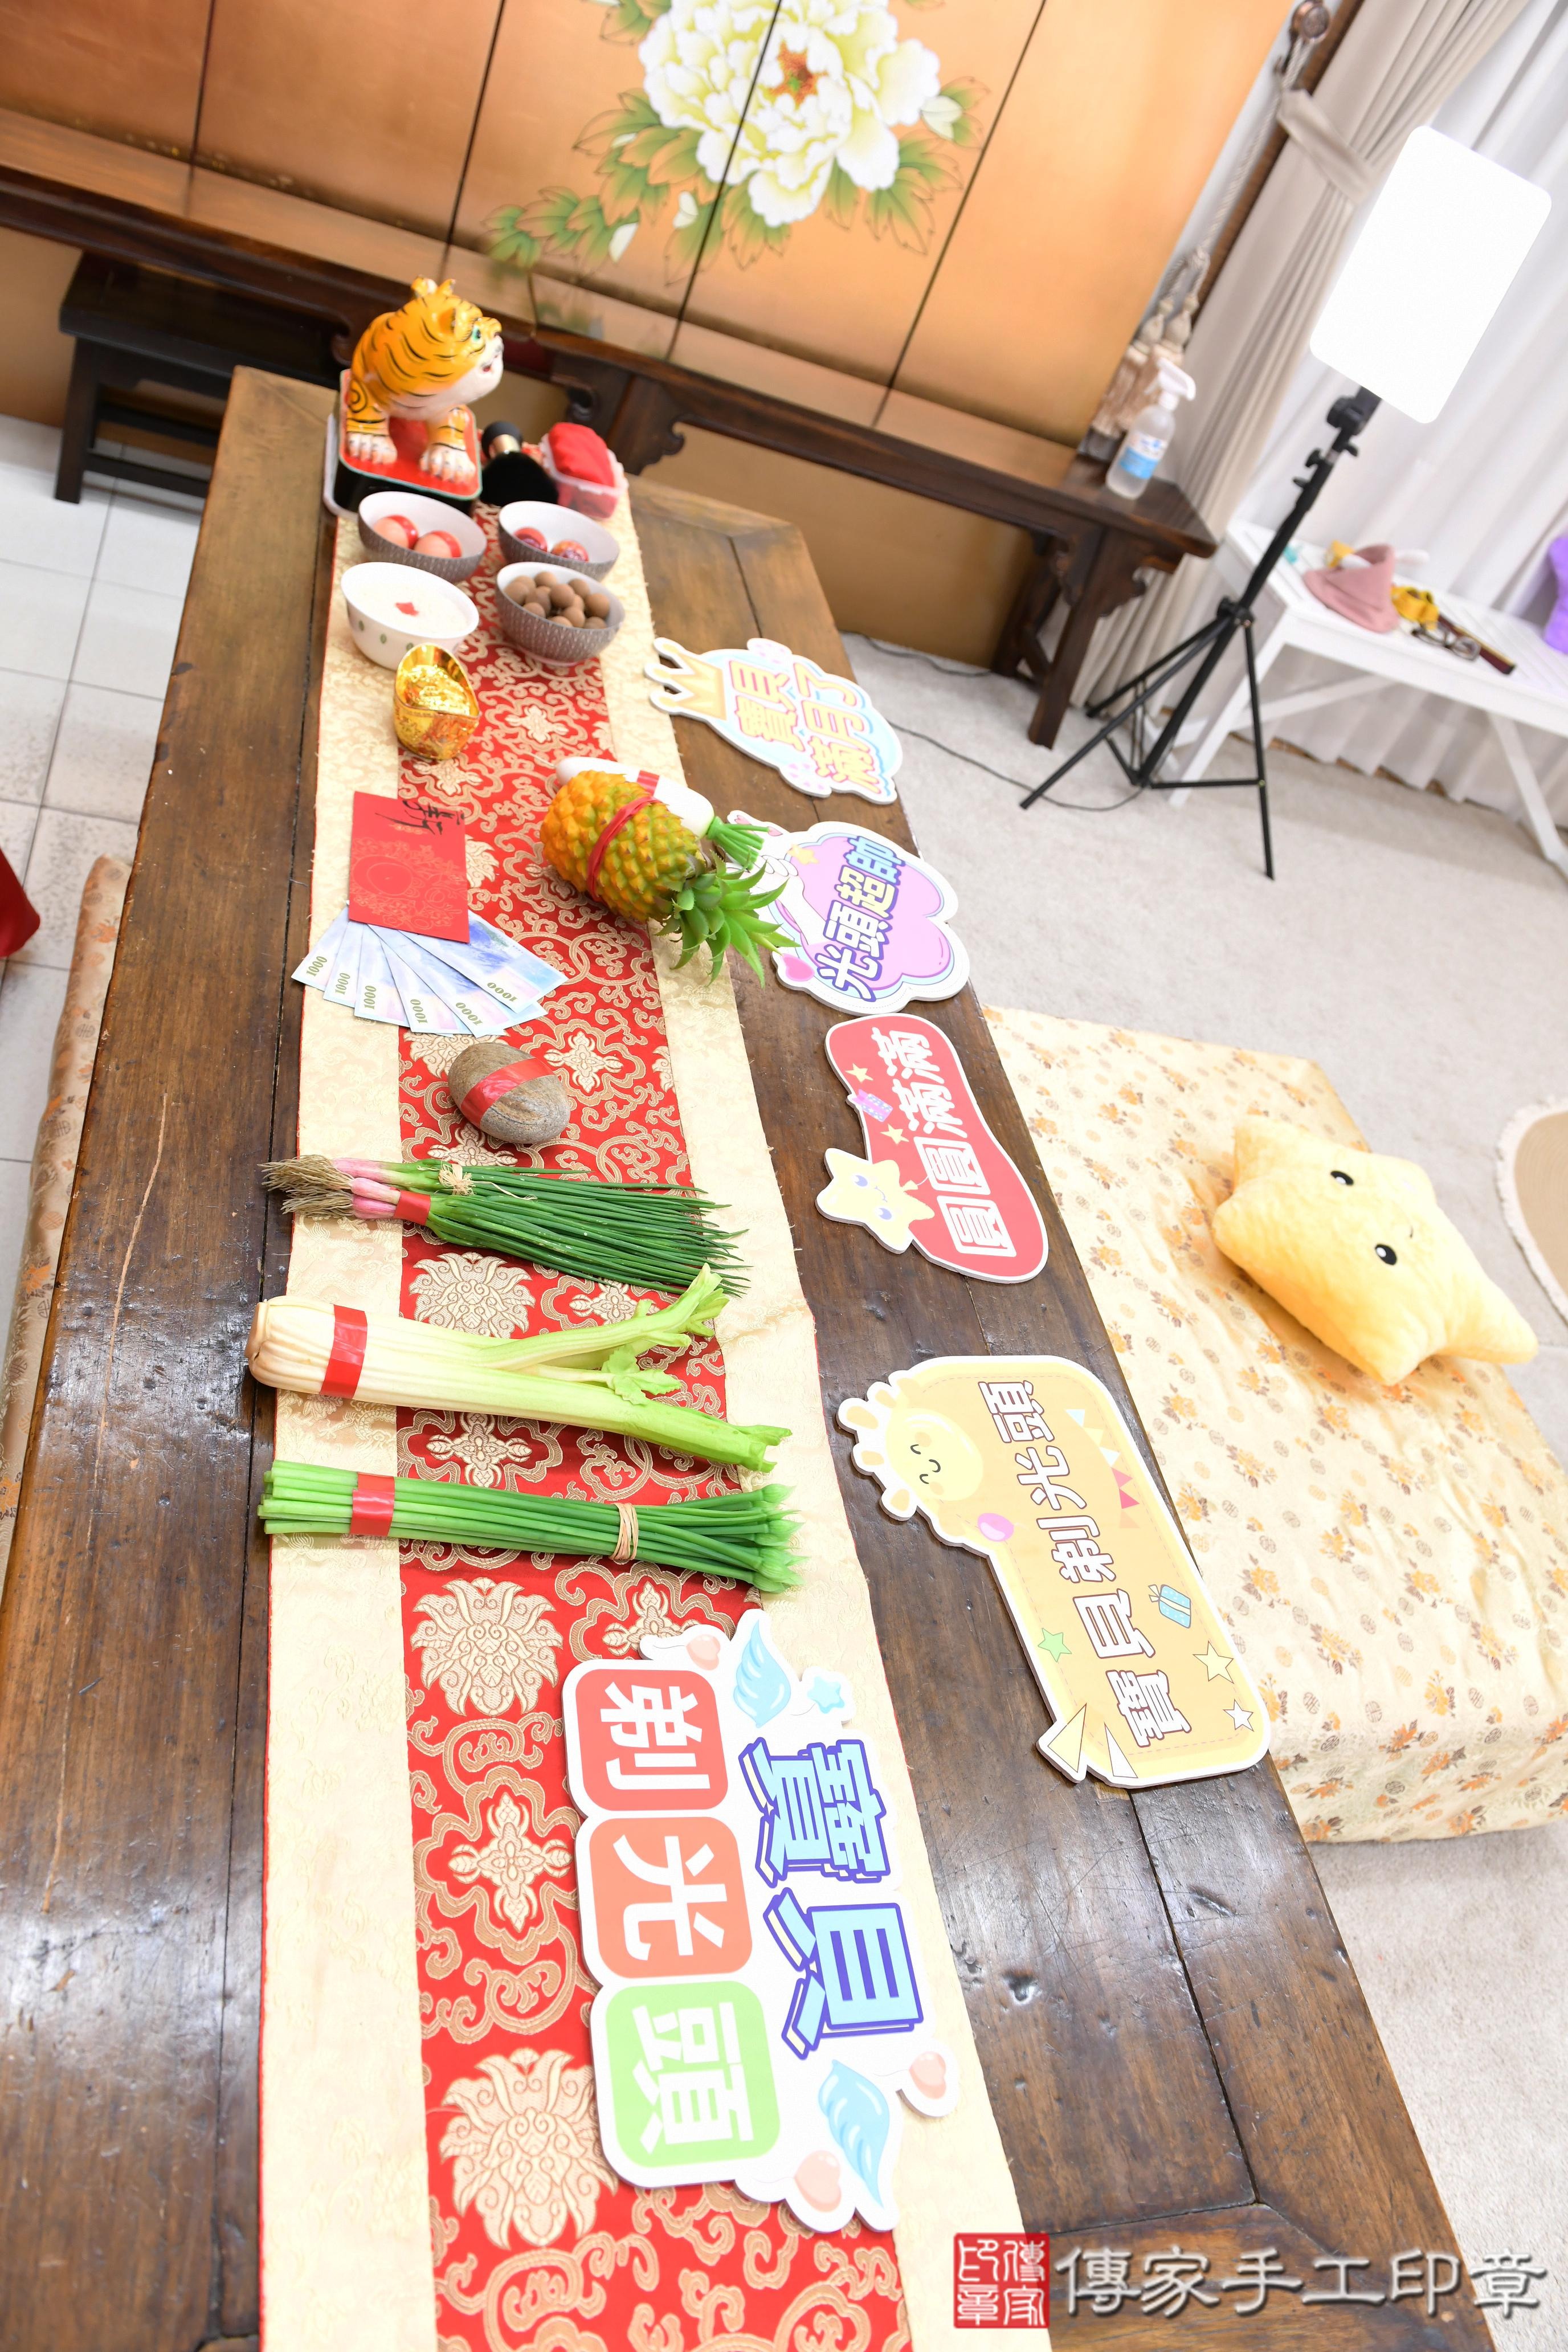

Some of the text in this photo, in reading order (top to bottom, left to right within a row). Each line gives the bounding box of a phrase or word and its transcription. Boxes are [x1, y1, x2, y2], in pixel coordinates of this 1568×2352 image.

[729, 660, 806, 752] 寶貝
[793, 662, 882, 795] 滿月了
[815, 836, 905, 1002] 光頭超帥
[305, 956, 328, 977] 1000
[334, 972, 352, 996] 1000
[363, 985, 377, 1011] 1000
[410, 999, 428, 1025] 1000
[487, 982, 518, 1003] 1000
[455, 1002, 485, 1026] 1000
[870, 1026, 1017, 1257] 圓圓滿滿
[978, 1380, 1193, 1748] 寶貝剃光頭
[600, 1681, 754, 2153] 剃光頭
[739, 1736, 924, 2061] 寶貝
